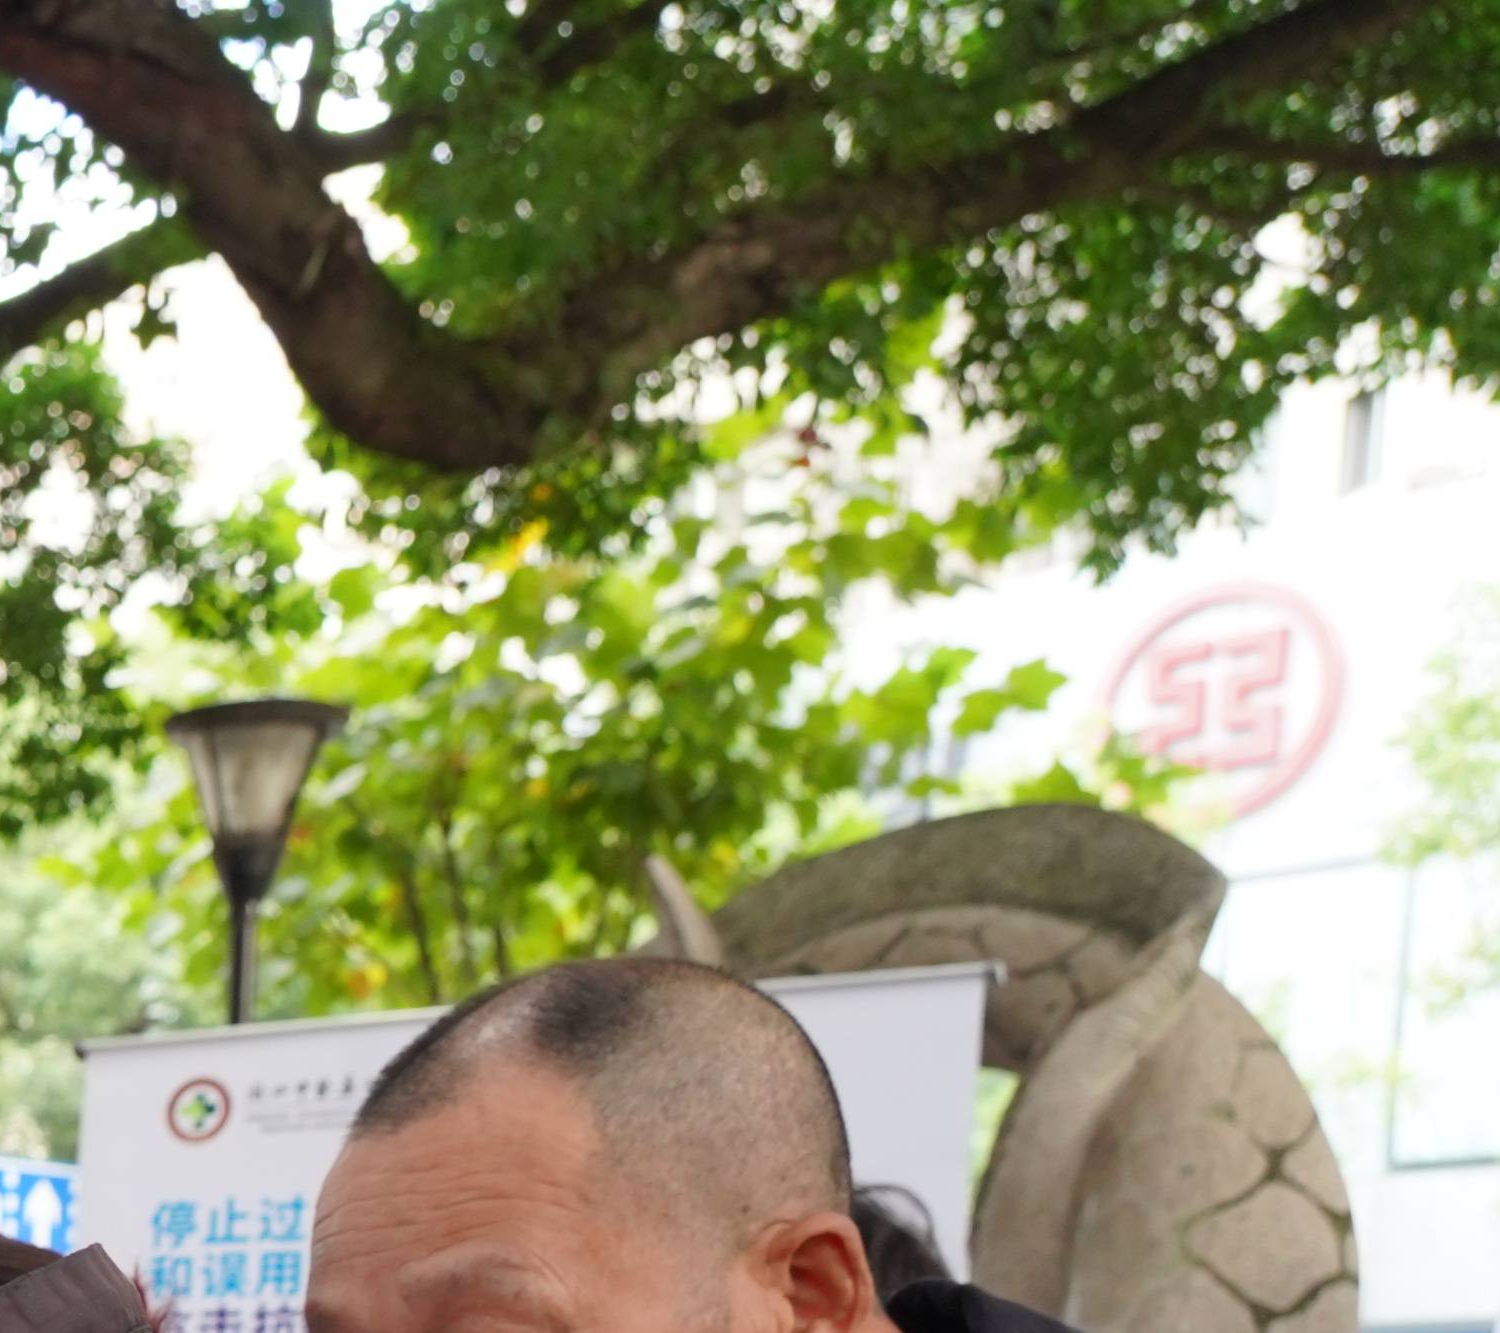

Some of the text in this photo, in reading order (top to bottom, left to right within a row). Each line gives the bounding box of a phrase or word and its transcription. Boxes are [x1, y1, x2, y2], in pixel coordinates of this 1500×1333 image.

[152, 1194, 304, 1247] 停止过
[151, 1252, 302, 1297] 和误用
